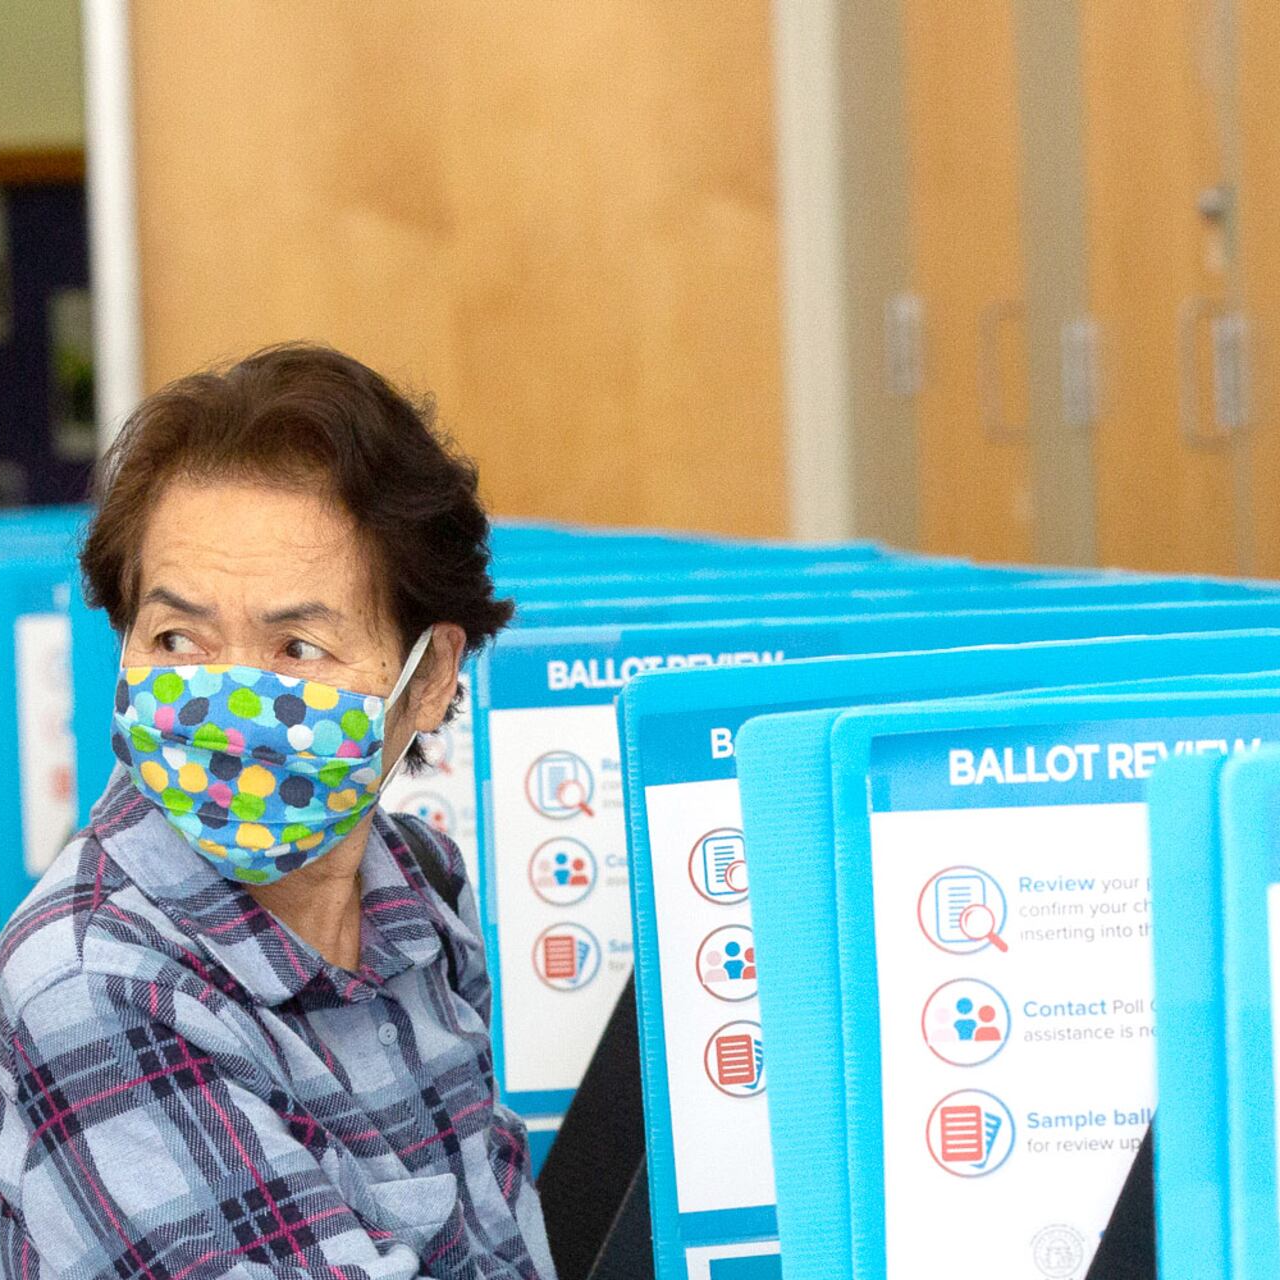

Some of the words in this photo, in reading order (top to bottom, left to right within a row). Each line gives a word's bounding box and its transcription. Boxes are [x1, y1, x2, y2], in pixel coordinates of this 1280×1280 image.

[546, 654, 663, 690] BALLO
[948, 744, 1100, 786] BALLOT
[1018, 875, 1096, 893] Review
[1101, 877, 1139, 894] your
[1019, 901, 1084, 918] confirm
[1089, 900, 1128, 919] your
[1020, 925, 1095, 943] inserting
[1100, 924, 1133, 939] into
[1023, 1000, 1108, 1018] Contact
[1112, 999, 1144, 1015] Poll
[1023, 1025, 1115, 1043] assistance
[1120, 1024, 1134, 1039] is
[1026, 1109, 1107, 1132] Sample
[1113, 1107, 1153, 1126] ball
[1027, 1137, 1051, 1153] for
[1056, 1137, 1114, 1152] review
[1119, 1136, 1142, 1152] up
